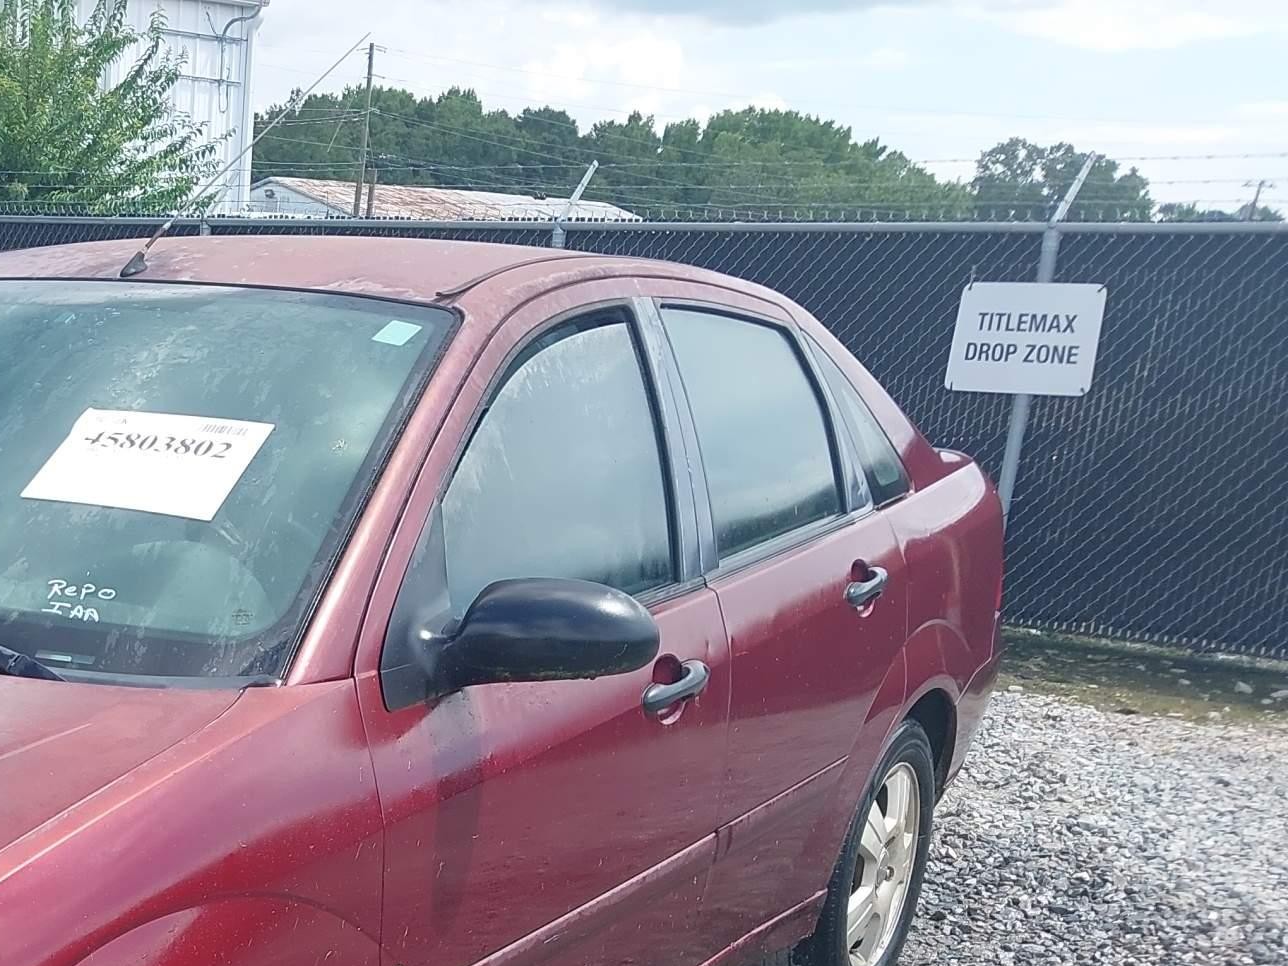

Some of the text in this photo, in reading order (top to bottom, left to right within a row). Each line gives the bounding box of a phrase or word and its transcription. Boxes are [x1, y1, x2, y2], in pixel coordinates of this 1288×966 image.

[978, 312, 1078, 334] TITLEMAX
[964, 341, 1080, 365] DROP ZONE
[84, 430, 233, 460] 45803802
[40, 601, 100, 623] IAA
